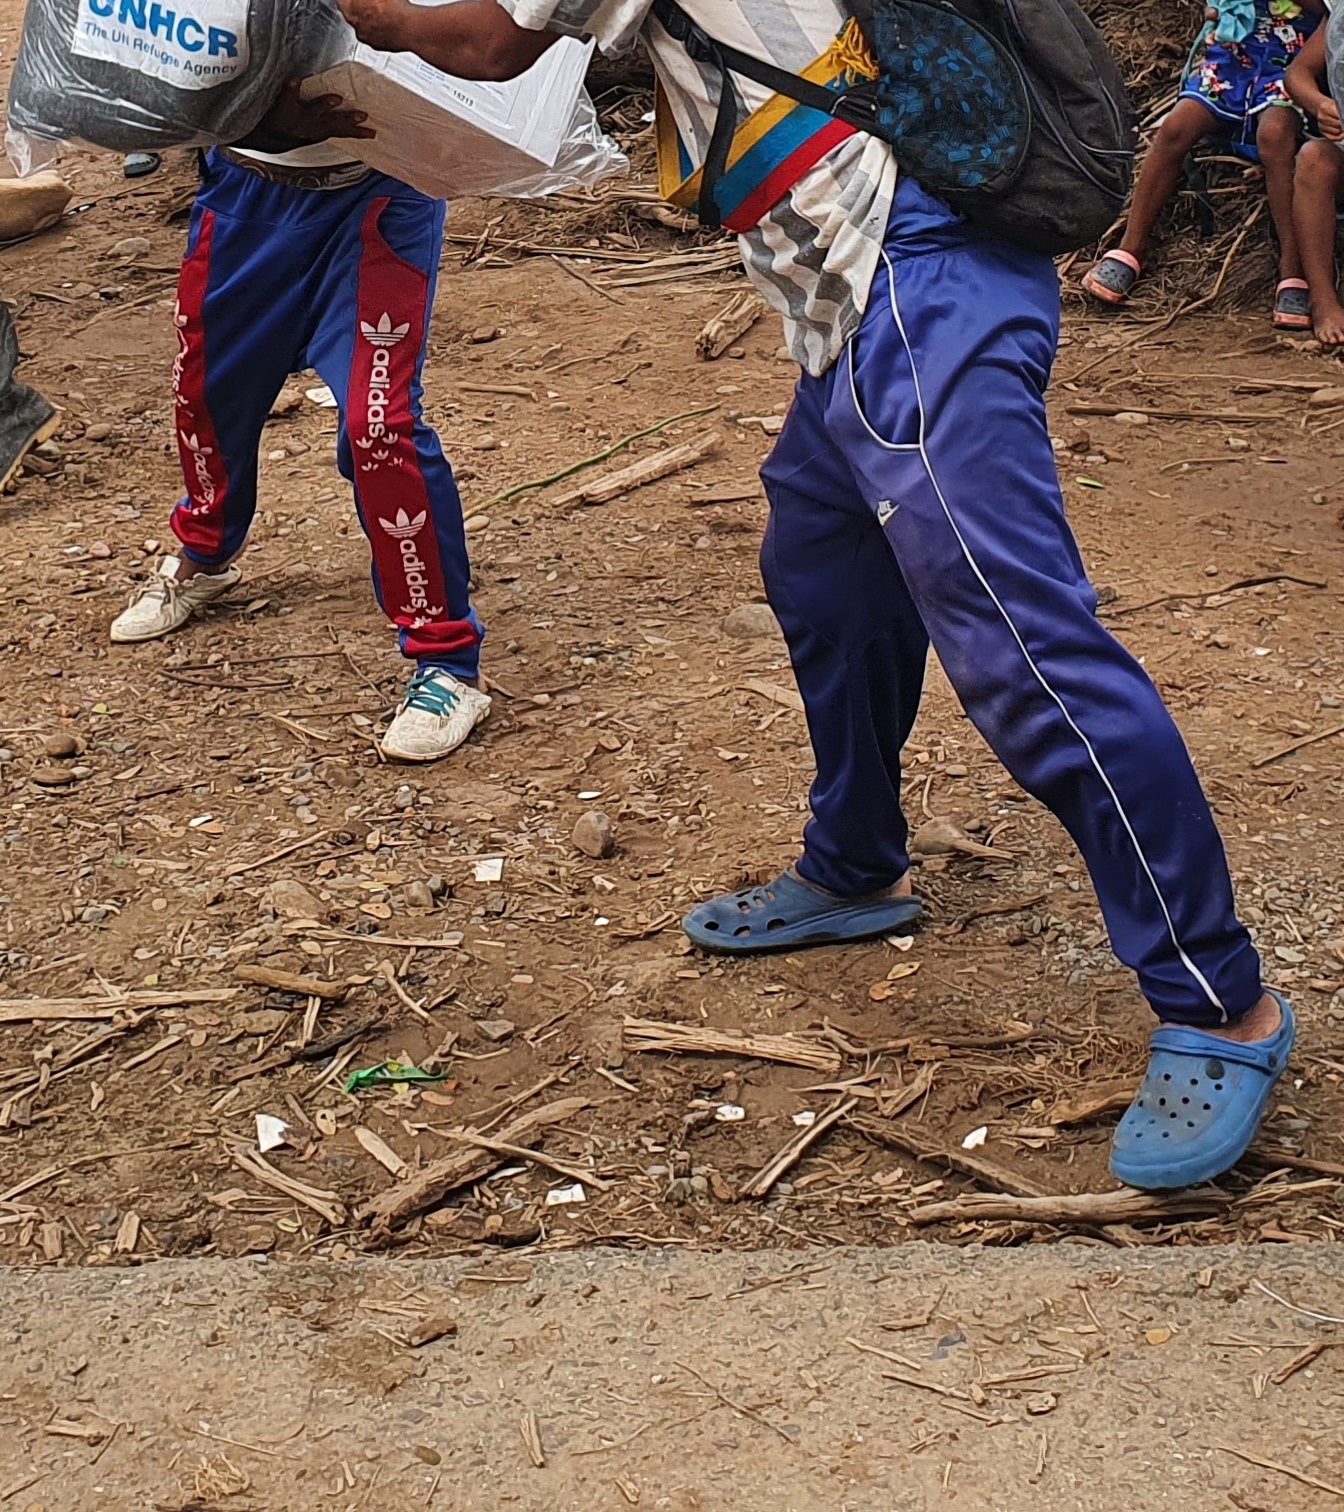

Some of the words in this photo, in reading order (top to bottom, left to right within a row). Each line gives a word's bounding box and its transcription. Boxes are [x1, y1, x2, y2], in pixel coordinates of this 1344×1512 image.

[84, 21, 108, 39] The
[184, 59, 238, 76] Agency
[367, 349, 390, 438] adidas
[400, 539, 428, 609] adidas
